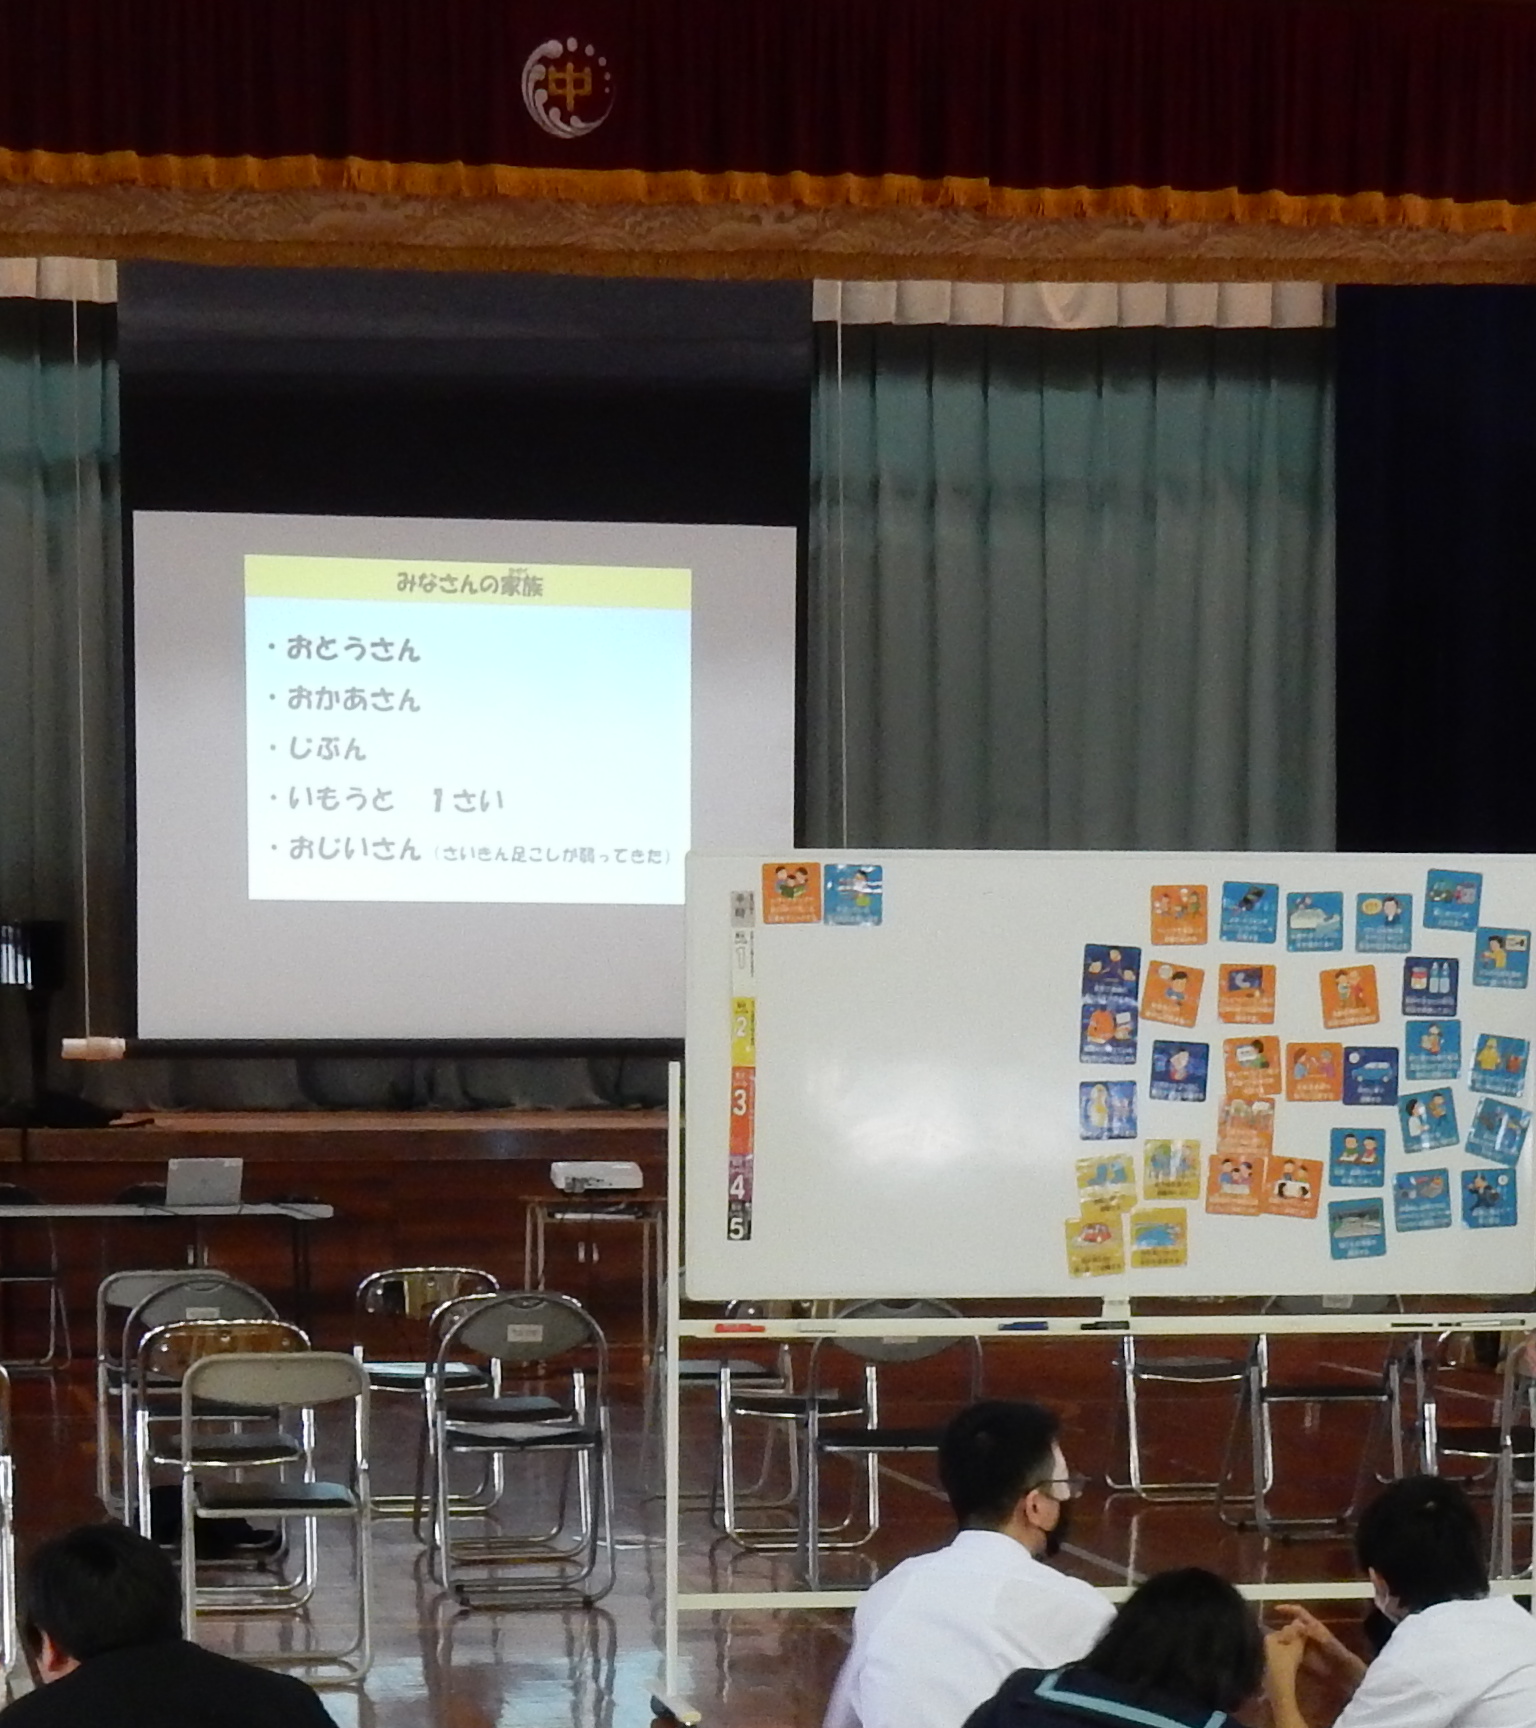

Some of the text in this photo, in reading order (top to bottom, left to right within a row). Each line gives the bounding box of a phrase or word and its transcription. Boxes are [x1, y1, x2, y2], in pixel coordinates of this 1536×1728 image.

[396, 570, 544, 598] みなさんの家族
[735, 1016, 747, 1037] 2
[732, 1088, 747, 1116] 3
[729, 1174, 745, 1200] 4
[729, 1217, 744, 1240] 5
